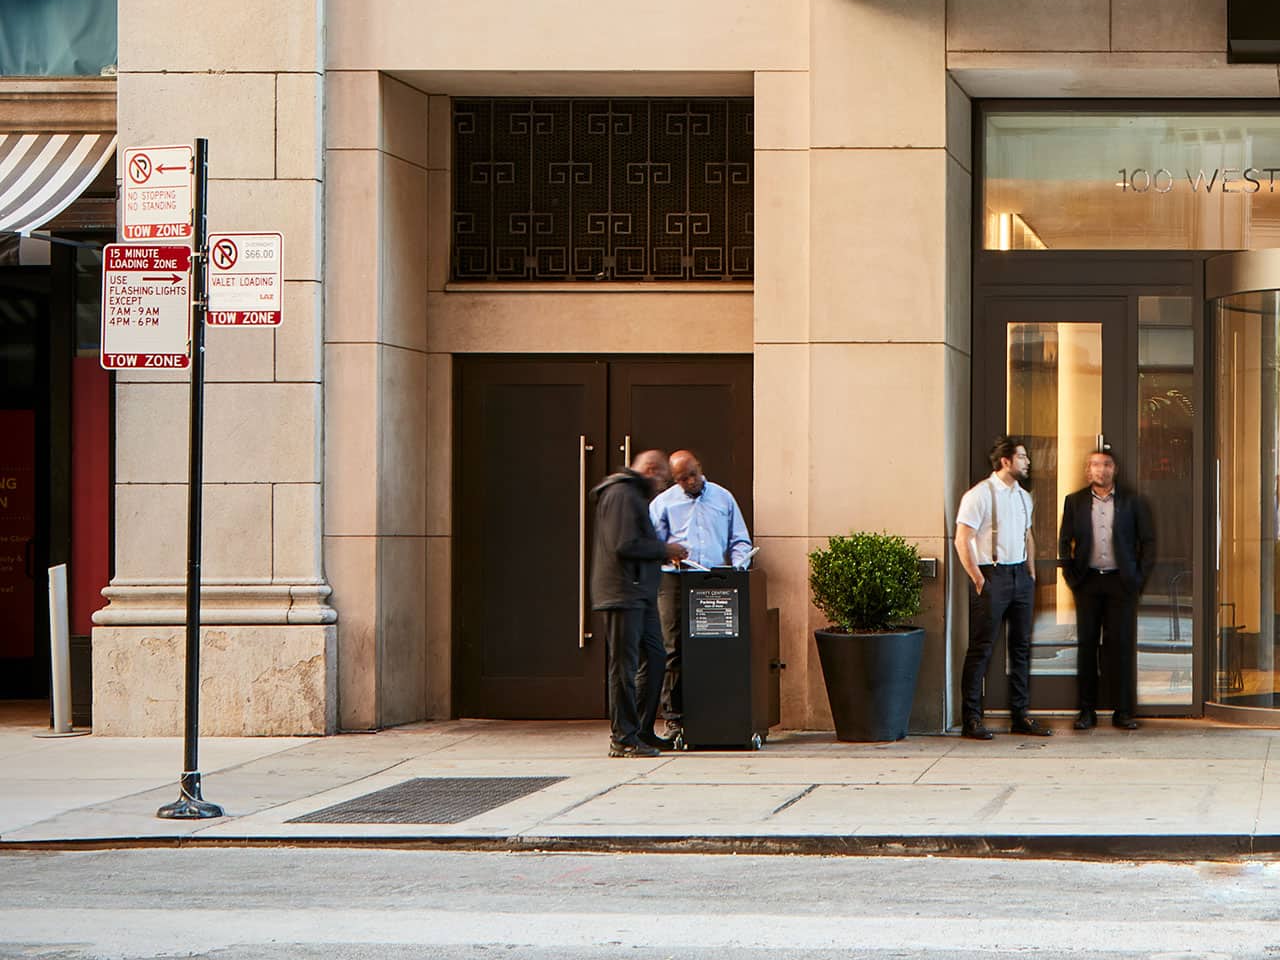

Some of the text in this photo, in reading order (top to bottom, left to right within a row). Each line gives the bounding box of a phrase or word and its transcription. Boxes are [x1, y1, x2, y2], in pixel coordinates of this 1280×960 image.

[1117, 168, 1173, 193] 100
[127, 190, 177, 201] NO STOPPING
[127, 201, 177, 212] NO STANDING
[127, 224, 187, 237] TOW ZONE
[110, 248, 159, 258] 15 MINUTE
[110, 259, 178, 269] LOADING ZONE
[110, 275, 128, 285] USE
[211, 277, 274, 287] VALET LOADING
[109, 286, 187, 295] FLASHING LIGHTS
[109, 296, 142, 305] EXCEPT
[210, 311, 276, 324] TOW ZONE
[108, 354, 183, 367] TOW ZONE
